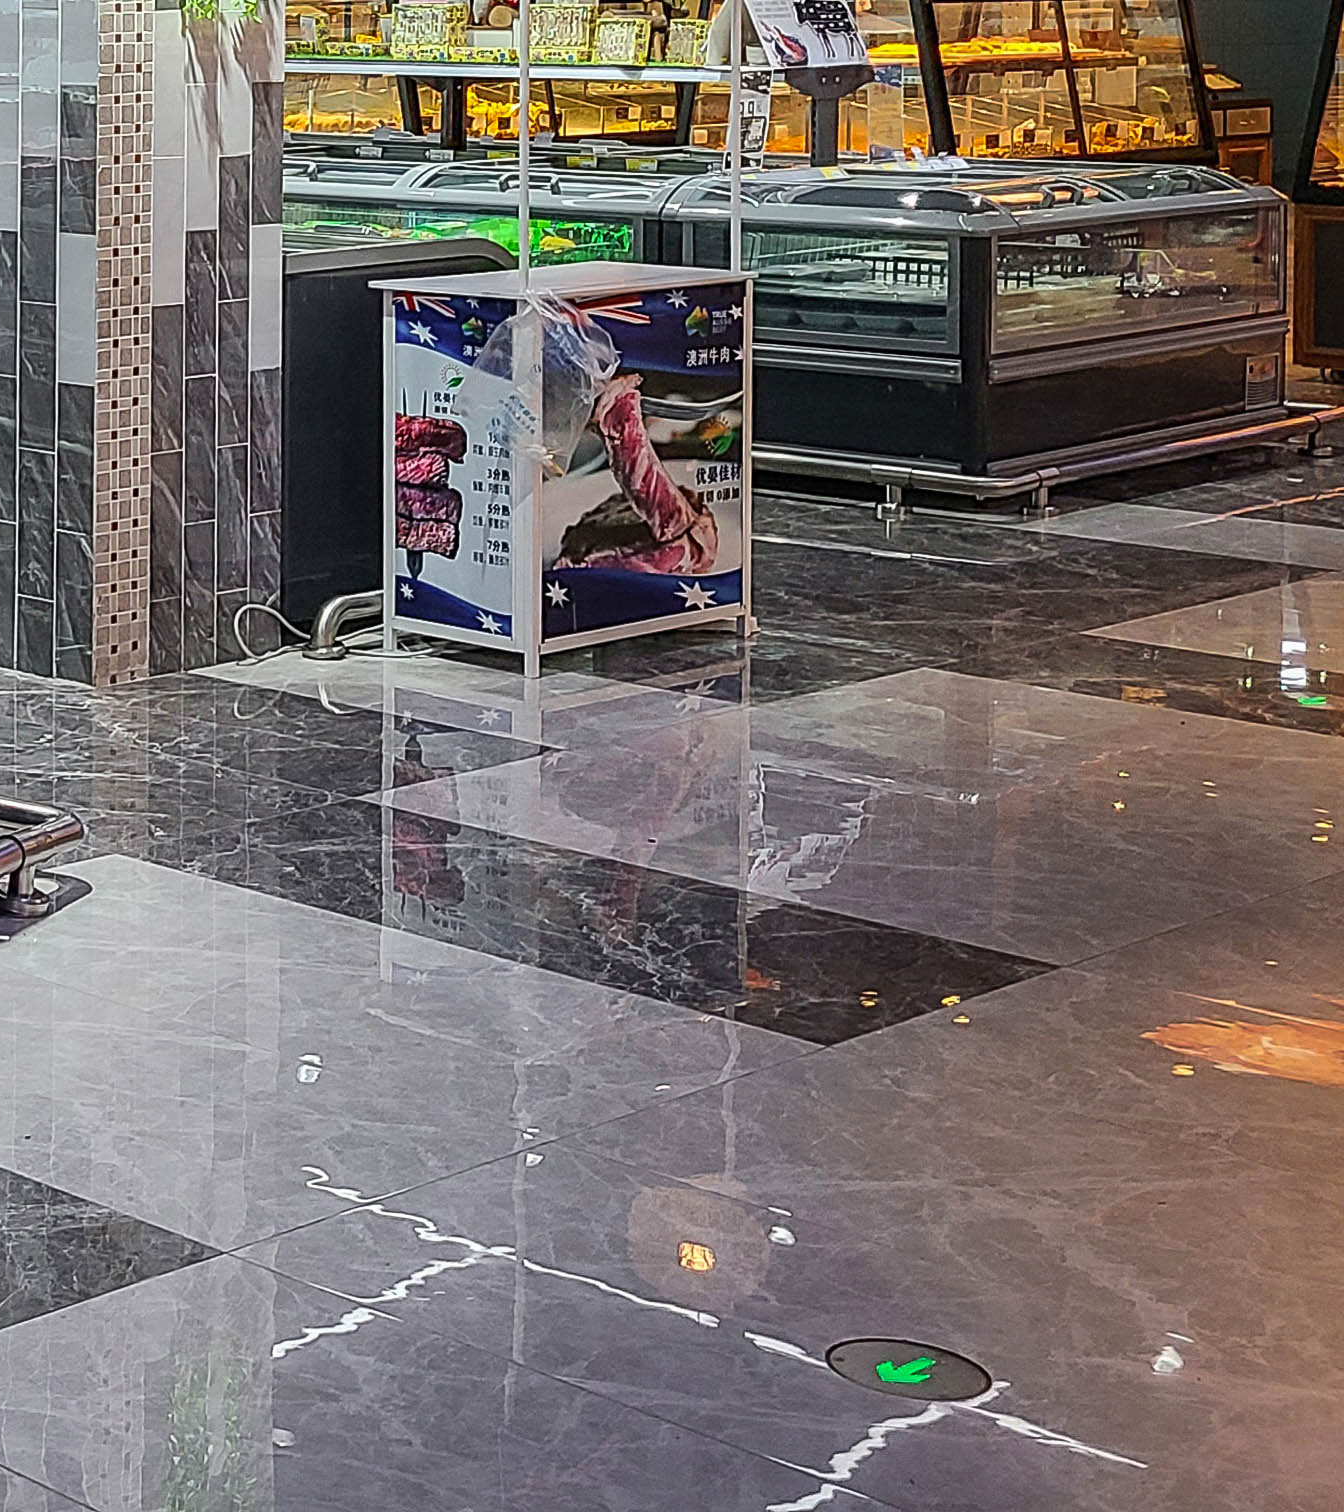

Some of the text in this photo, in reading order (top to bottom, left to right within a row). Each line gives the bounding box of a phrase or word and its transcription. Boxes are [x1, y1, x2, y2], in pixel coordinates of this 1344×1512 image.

[686, 346, 730, 368] 澳洲牛肉
[487, 468, 511, 482] 3分熟
[487, 503, 511, 517] 5分熟
[487, 540, 510, 554] 7分熟
